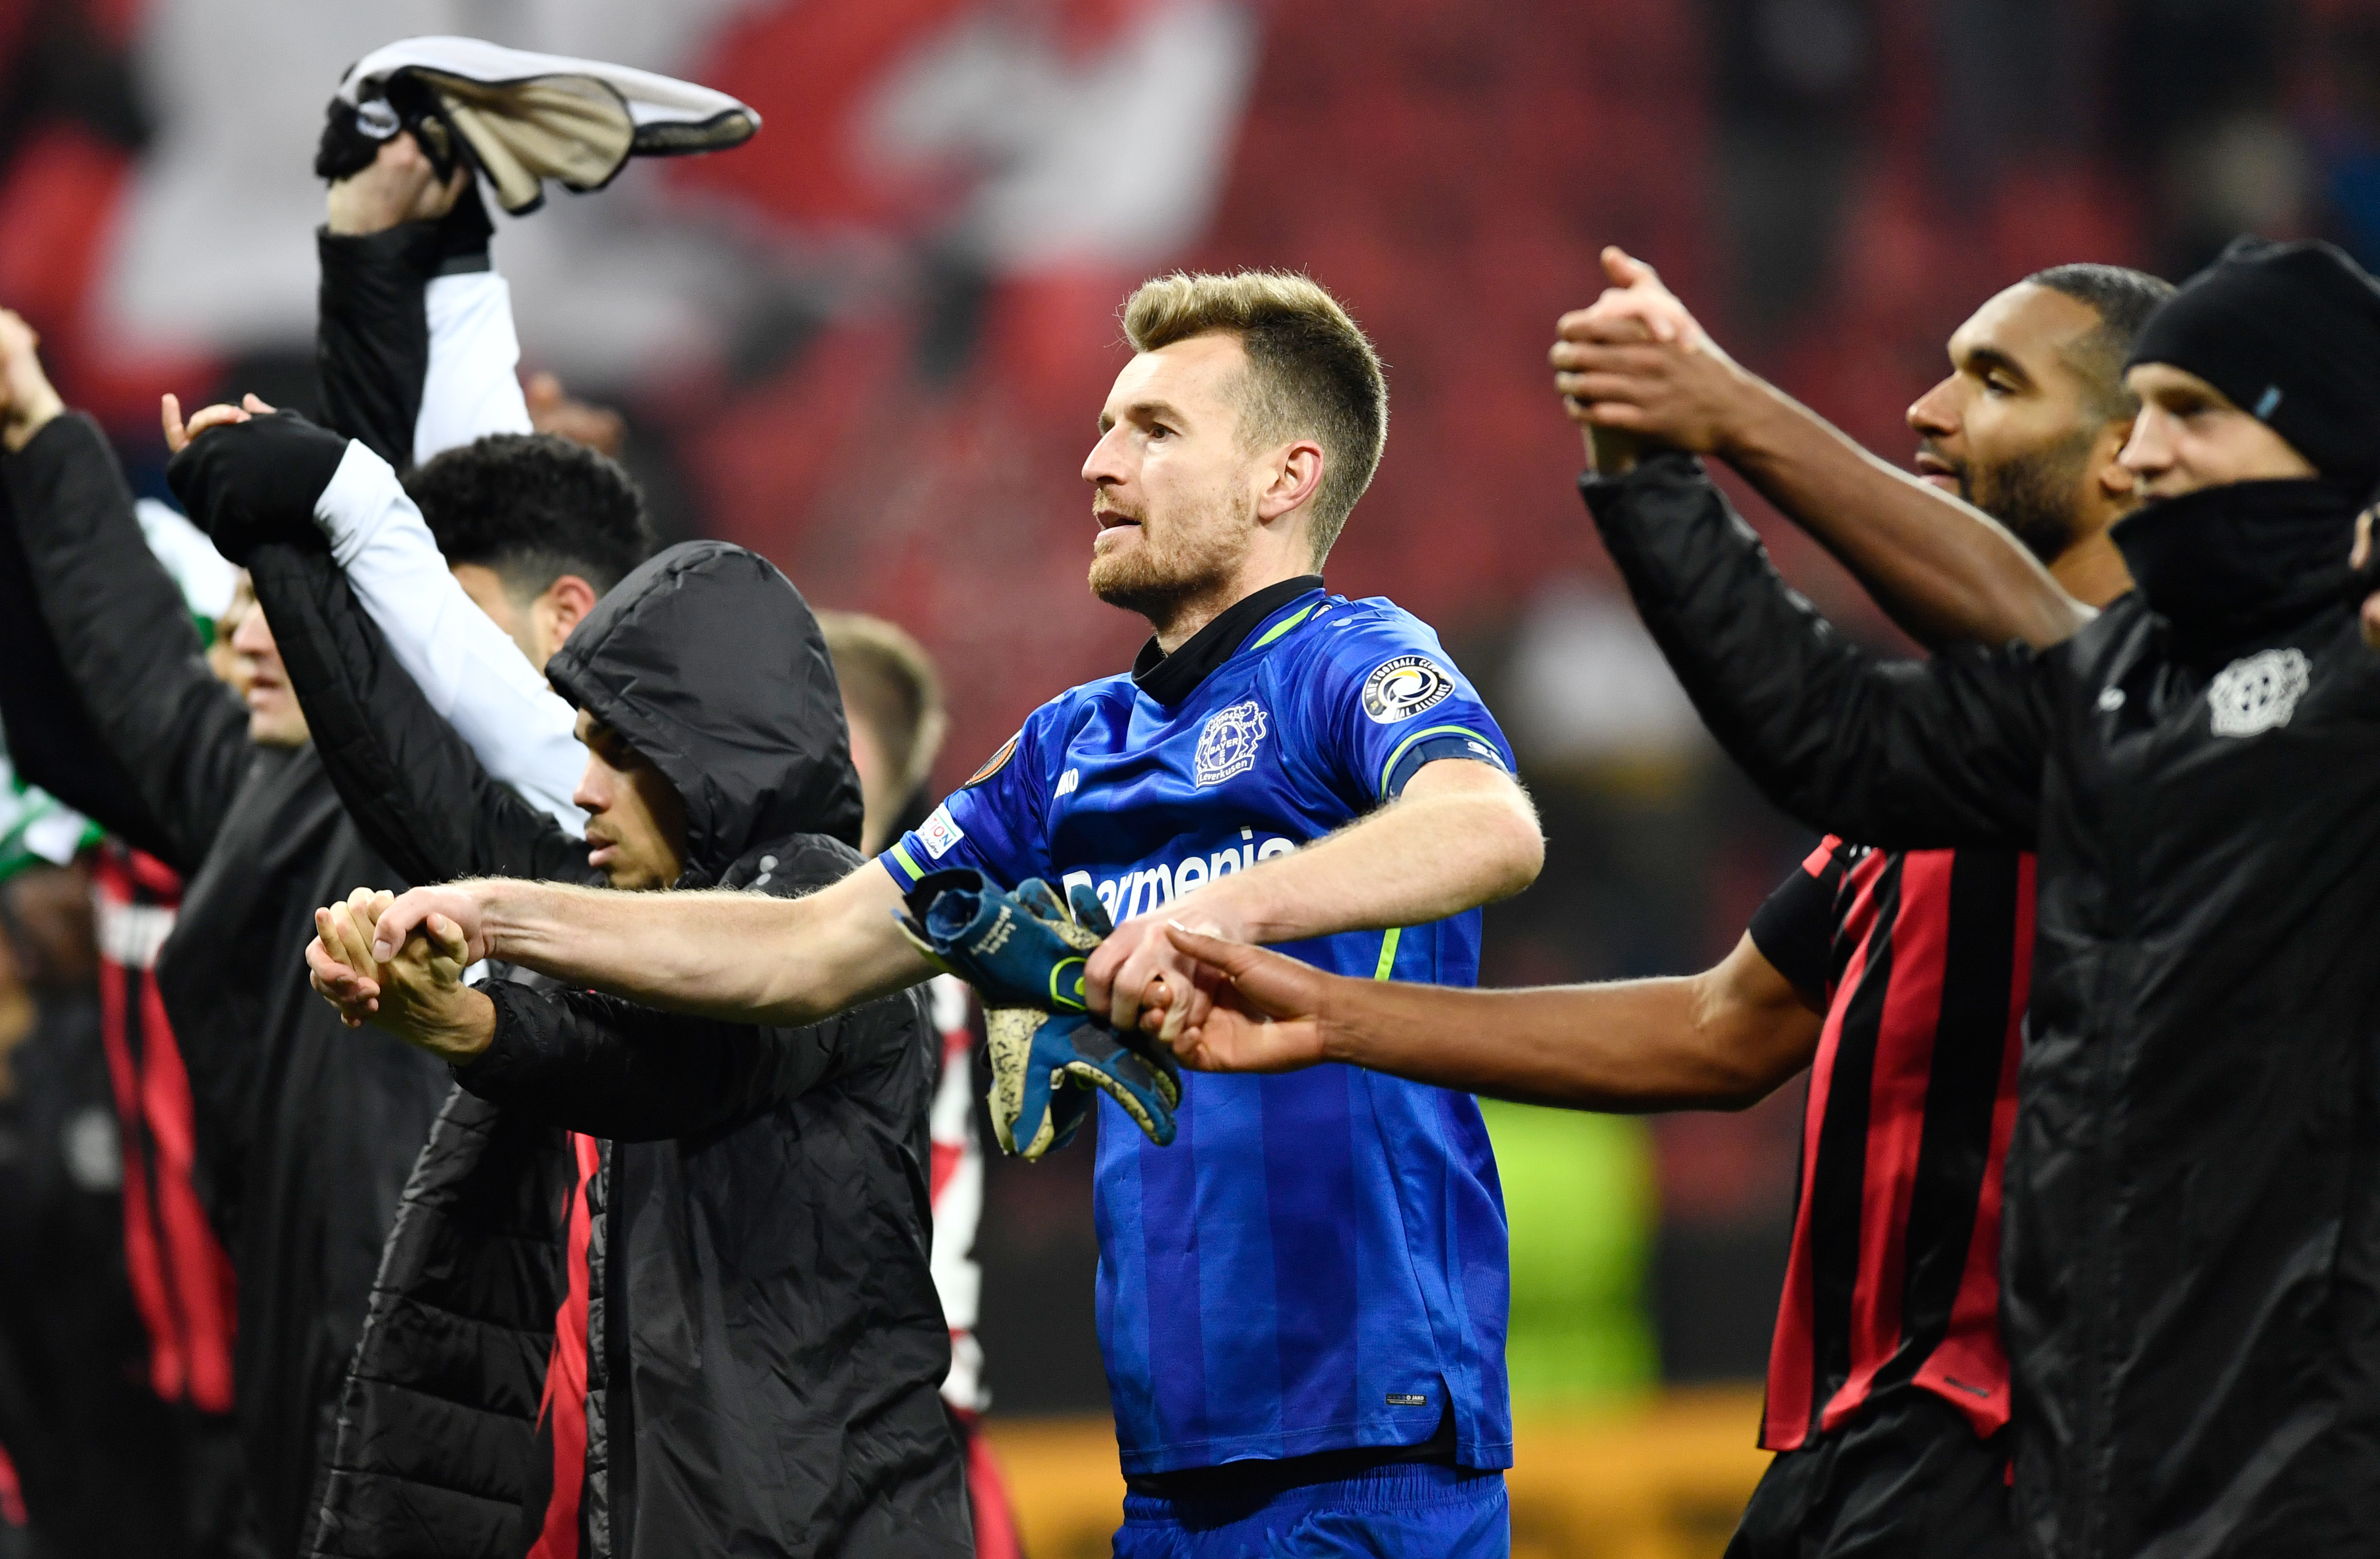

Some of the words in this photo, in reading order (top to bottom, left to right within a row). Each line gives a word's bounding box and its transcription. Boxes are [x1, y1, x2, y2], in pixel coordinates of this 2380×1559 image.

[1372, 658, 1415, 680] FOOTBALL
[1366, 682, 1379, 699] THE
[1415, 683, 1451, 712] ALLIANCE
[1218, 712, 1233, 724] 1904
[1210, 737, 1238, 755] BAYER
[1219, 726, 1228, 765] BAYER
[1200, 760, 1248, 782] Leverkusen
[1054, 768, 1078, 799] AKO
